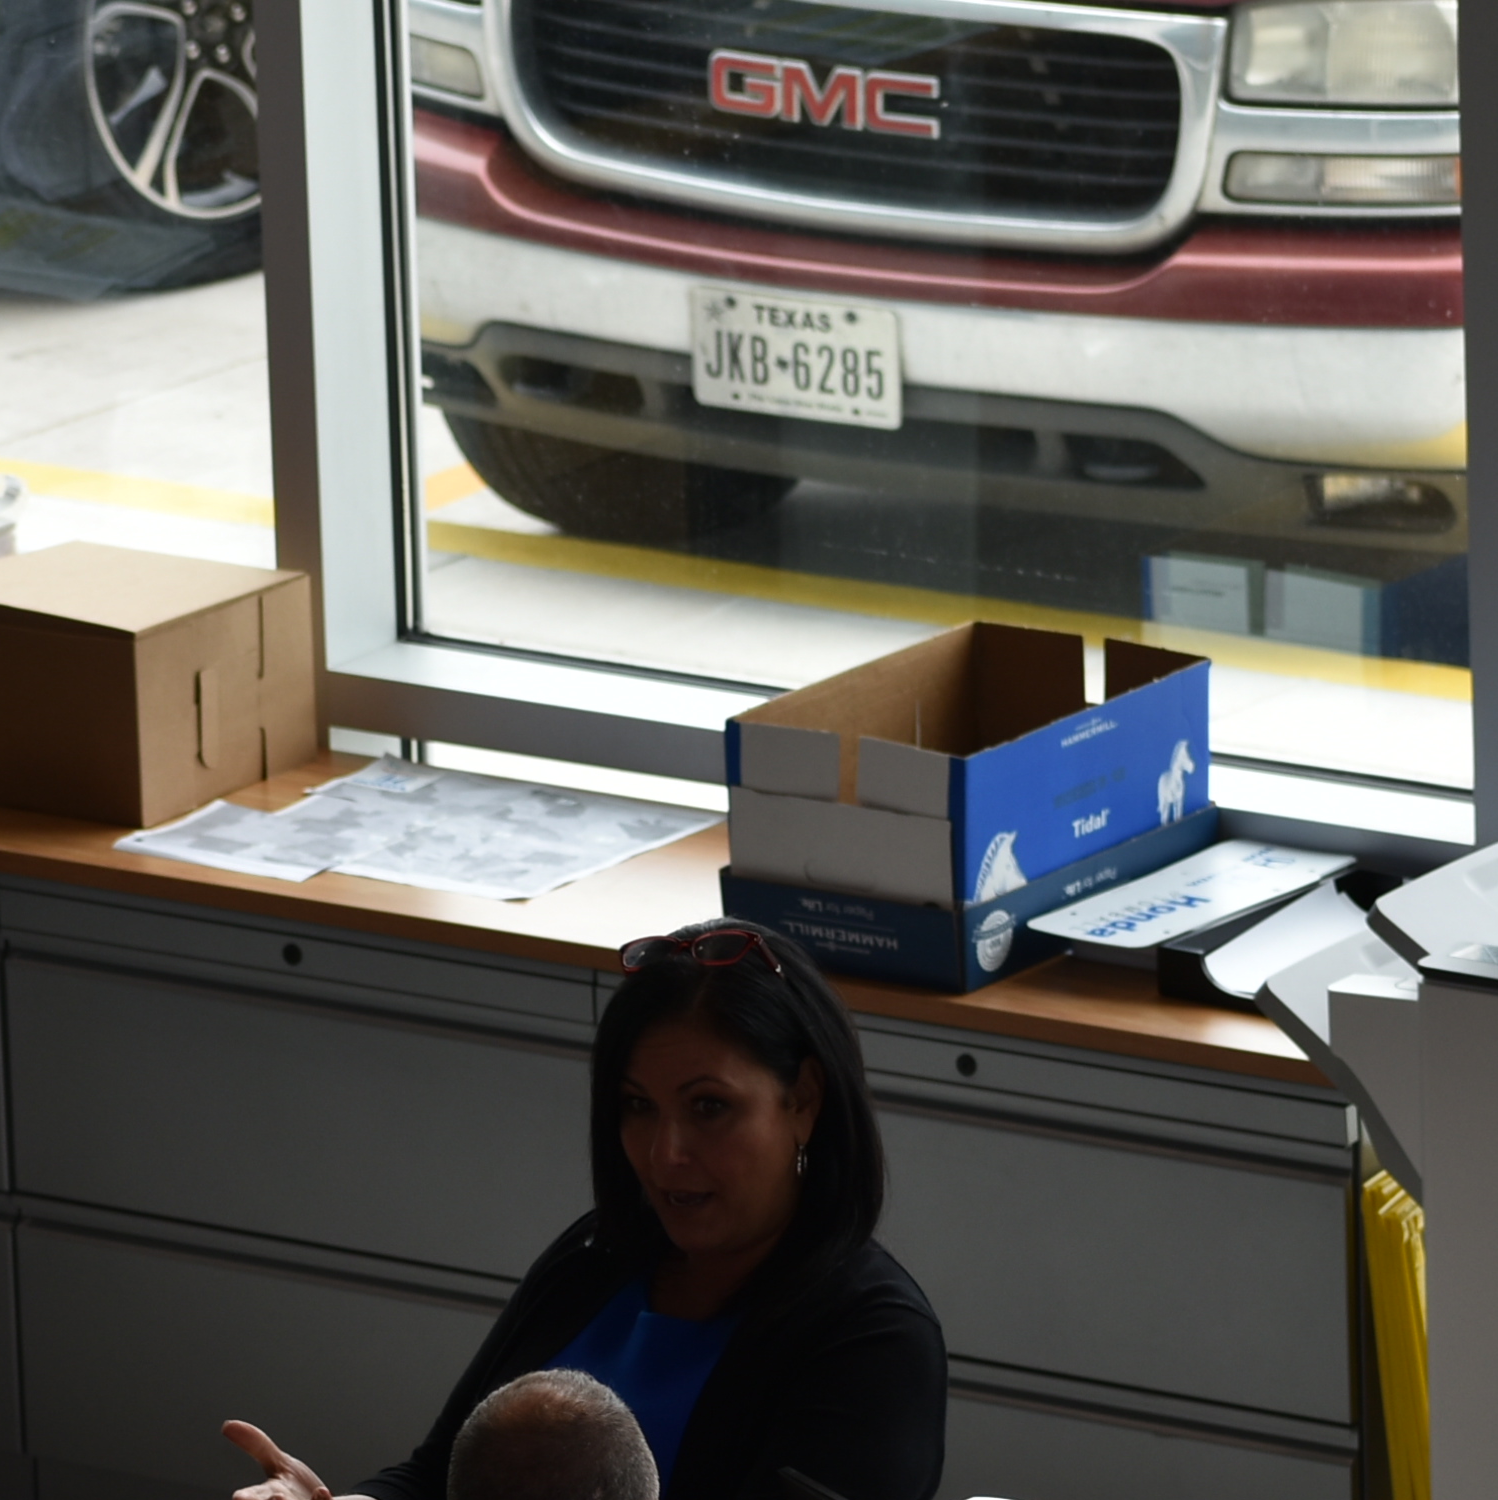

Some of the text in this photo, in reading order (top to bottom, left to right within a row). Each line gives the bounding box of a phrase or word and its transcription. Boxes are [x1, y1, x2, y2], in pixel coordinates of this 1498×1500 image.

[707, 48, 941, 140] GMC
[753, 304, 832, 333] TEXAS
[1071, 811, 1108, 839] Tidal
[1085, 895, 1211, 938] Honda
[784, 921, 899, 951] HAMMERMILL
